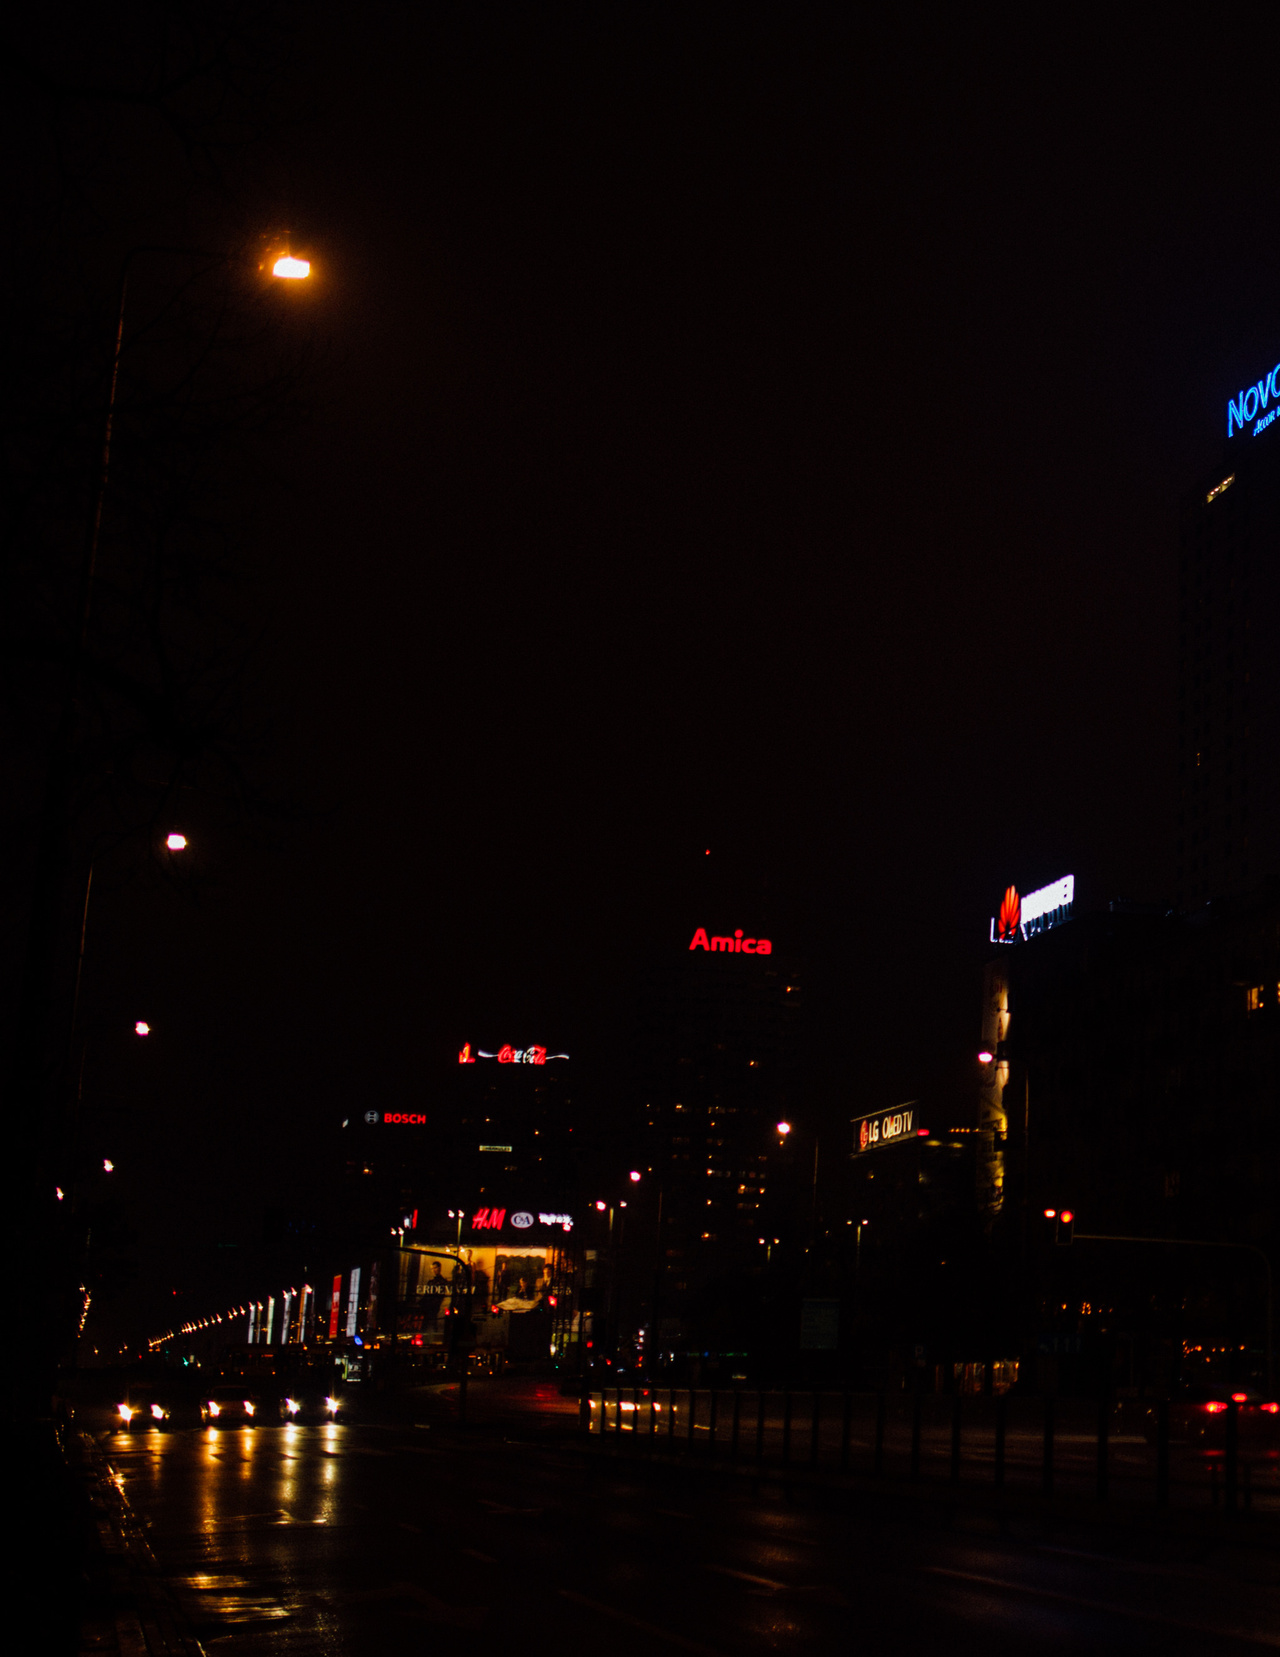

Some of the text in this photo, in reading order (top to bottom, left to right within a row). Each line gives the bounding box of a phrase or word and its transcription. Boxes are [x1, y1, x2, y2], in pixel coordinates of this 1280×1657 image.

[688, 927, 773, 955] Amica
[383, 1112, 427, 1125] BOSCH
[868, 1110, 914, 1144] LG OLED TV
[471, 1207, 507, 1231] H&M
[513, 1214, 532, 1226] C&A
